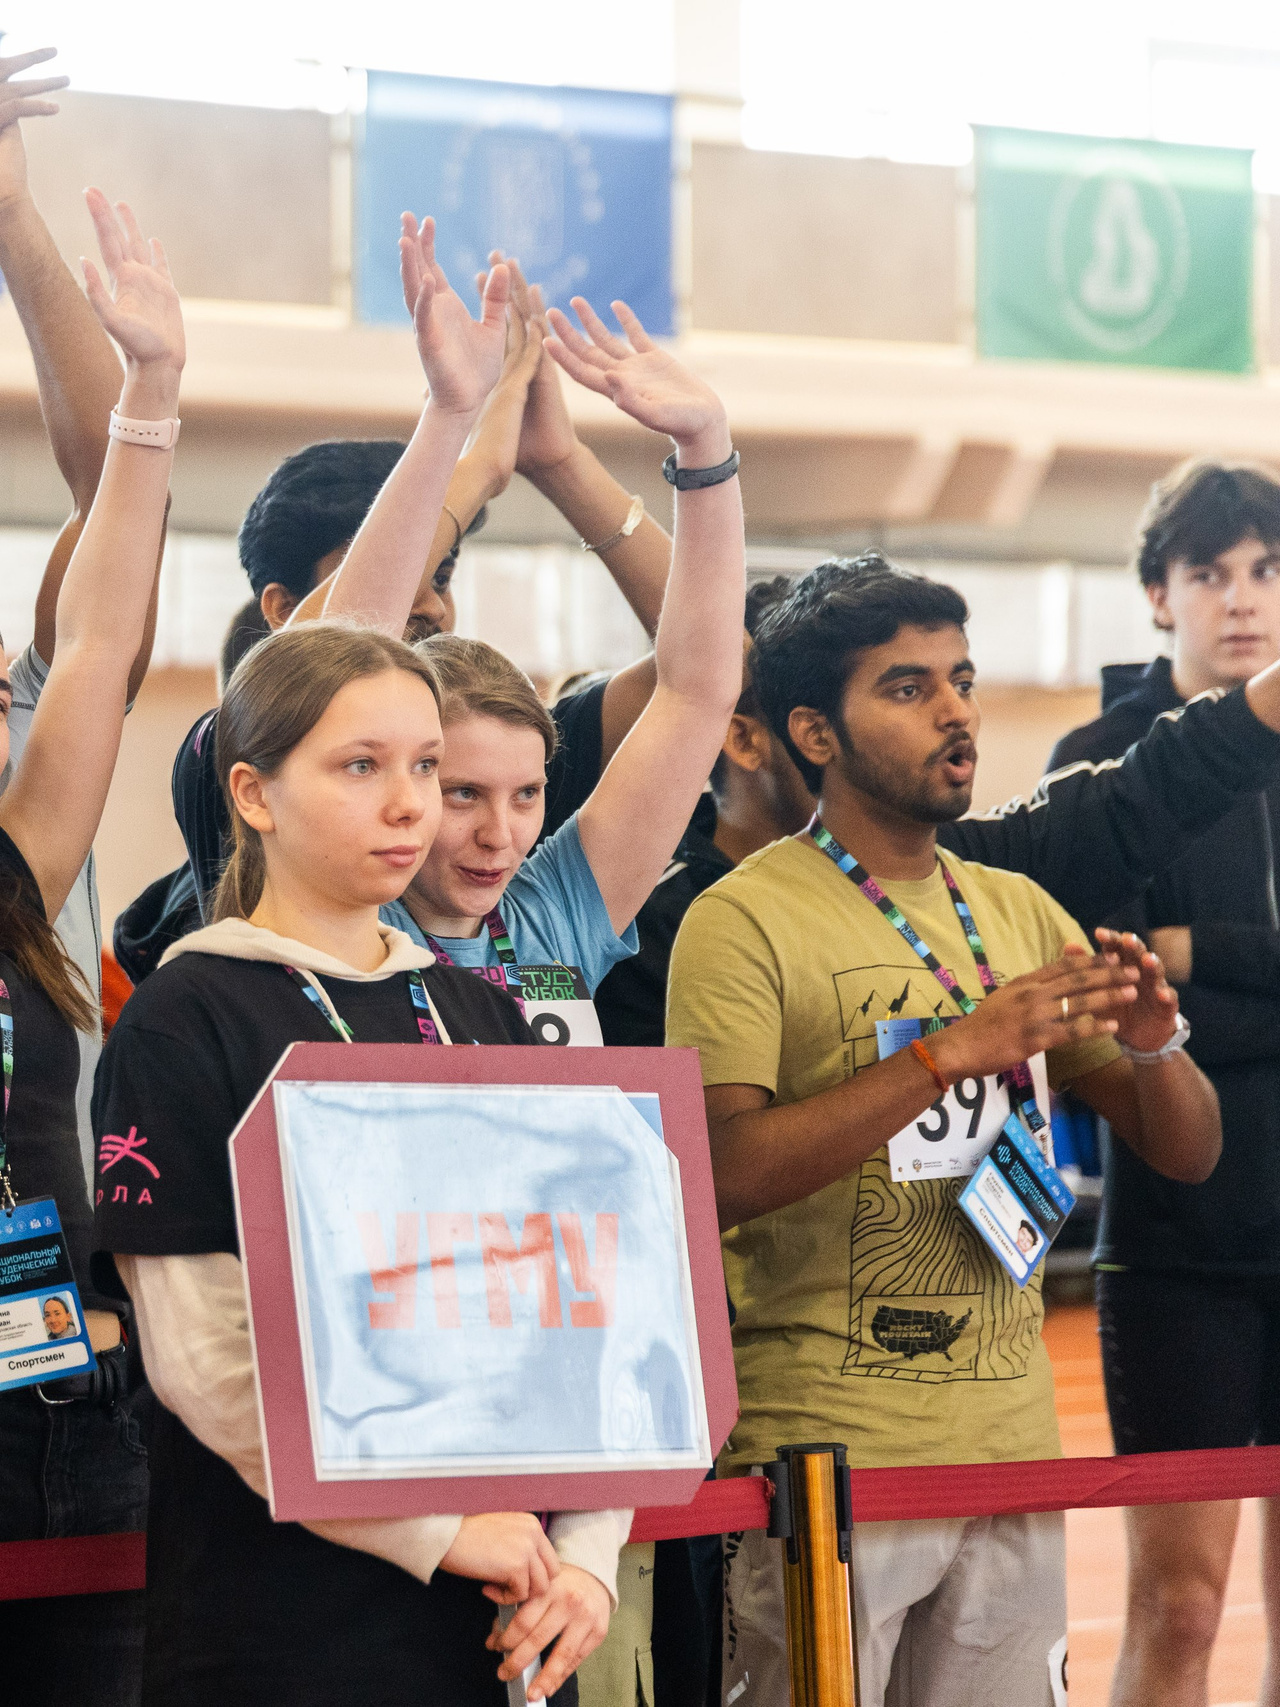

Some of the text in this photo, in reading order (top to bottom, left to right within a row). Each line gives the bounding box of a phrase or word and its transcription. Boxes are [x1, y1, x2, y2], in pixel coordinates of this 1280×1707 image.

[354, 1212, 620, 1330] УГМУ
[890, 1324, 923, 1332] ROCKY
[8, 1351, 65, 1371] Спортсмен
